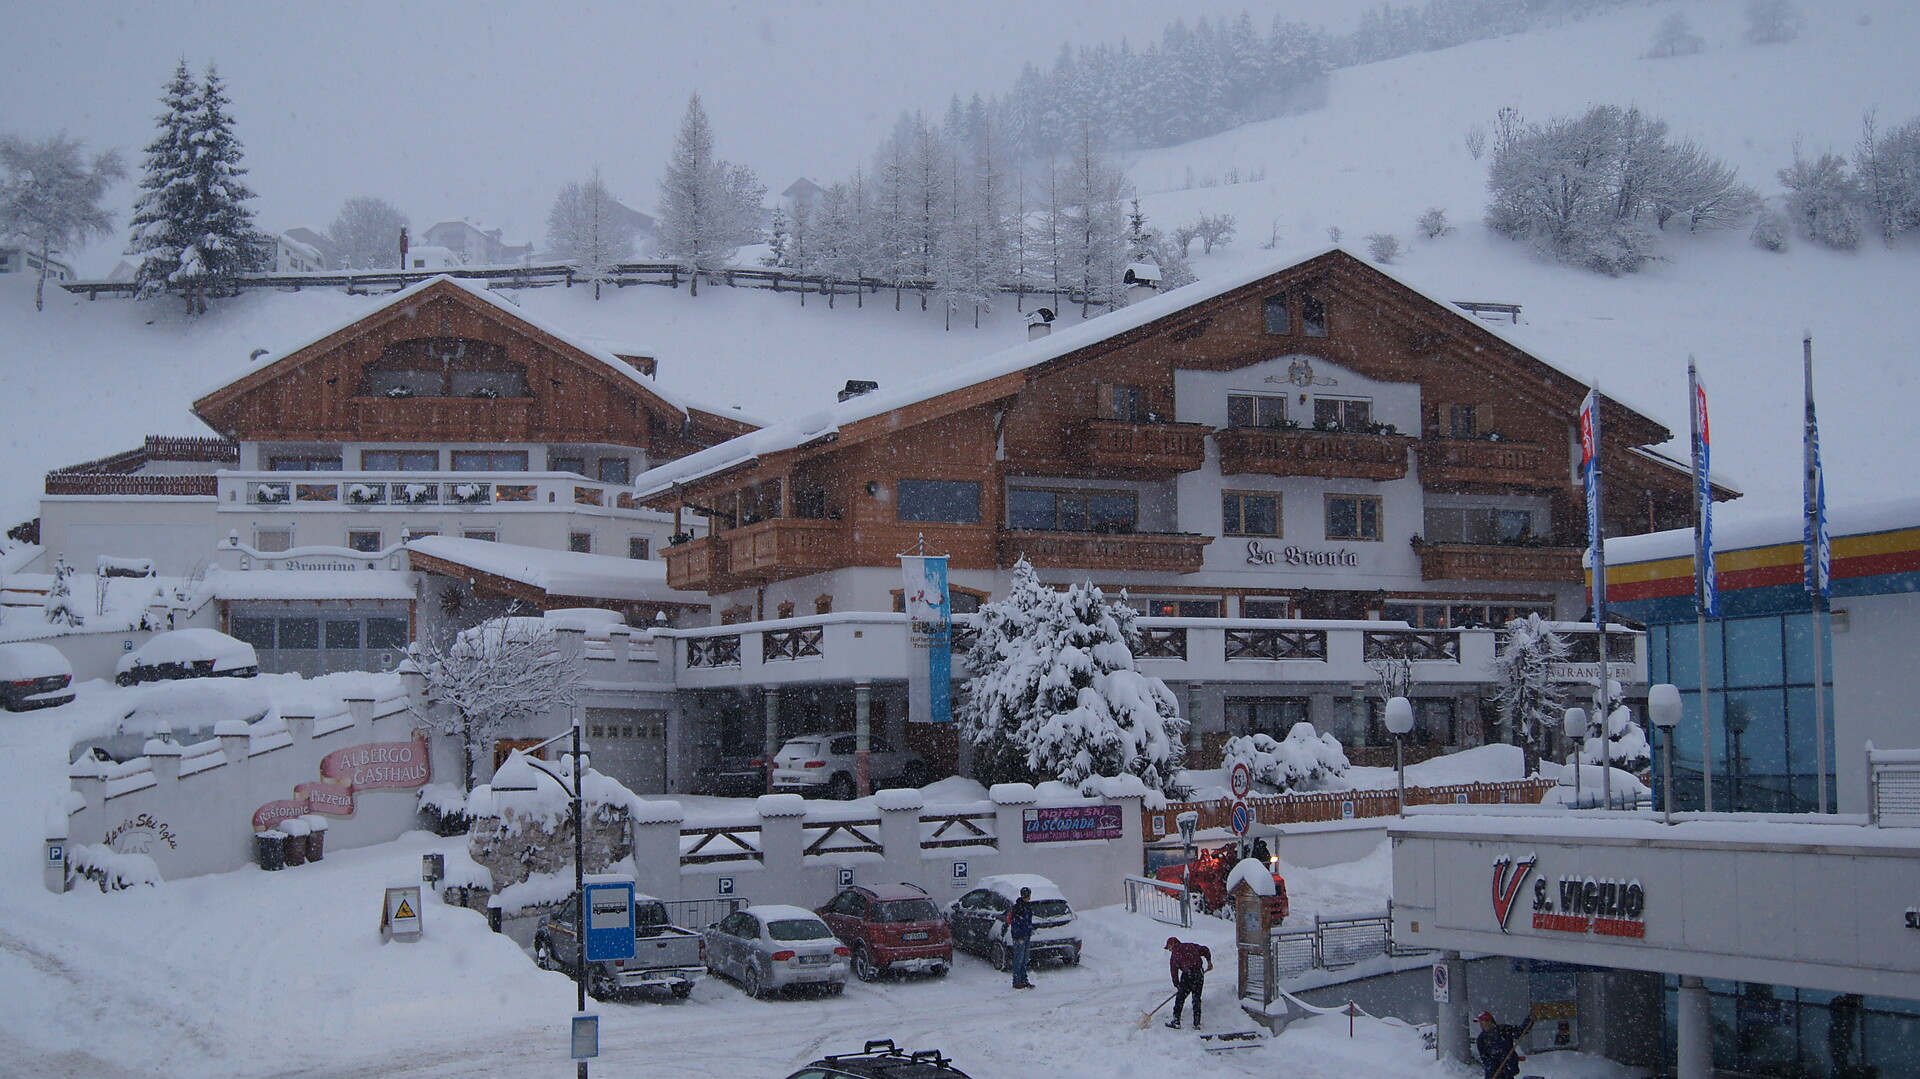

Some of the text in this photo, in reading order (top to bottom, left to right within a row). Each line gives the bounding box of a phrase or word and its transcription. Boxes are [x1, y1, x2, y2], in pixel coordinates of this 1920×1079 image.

[1247, 540, 1358, 566] La Bronta
[340, 748, 412, 770] ALBERGO
[354, 763, 427, 785] GASTHAUS
[310, 789, 351, 806] Pizzeria
[135, 813, 158, 829] Ski
[259, 804, 310, 825] Ristorante
[1027, 820, 1039, 832] LA
[1533, 875, 1644, 917] S. VIGILIO
